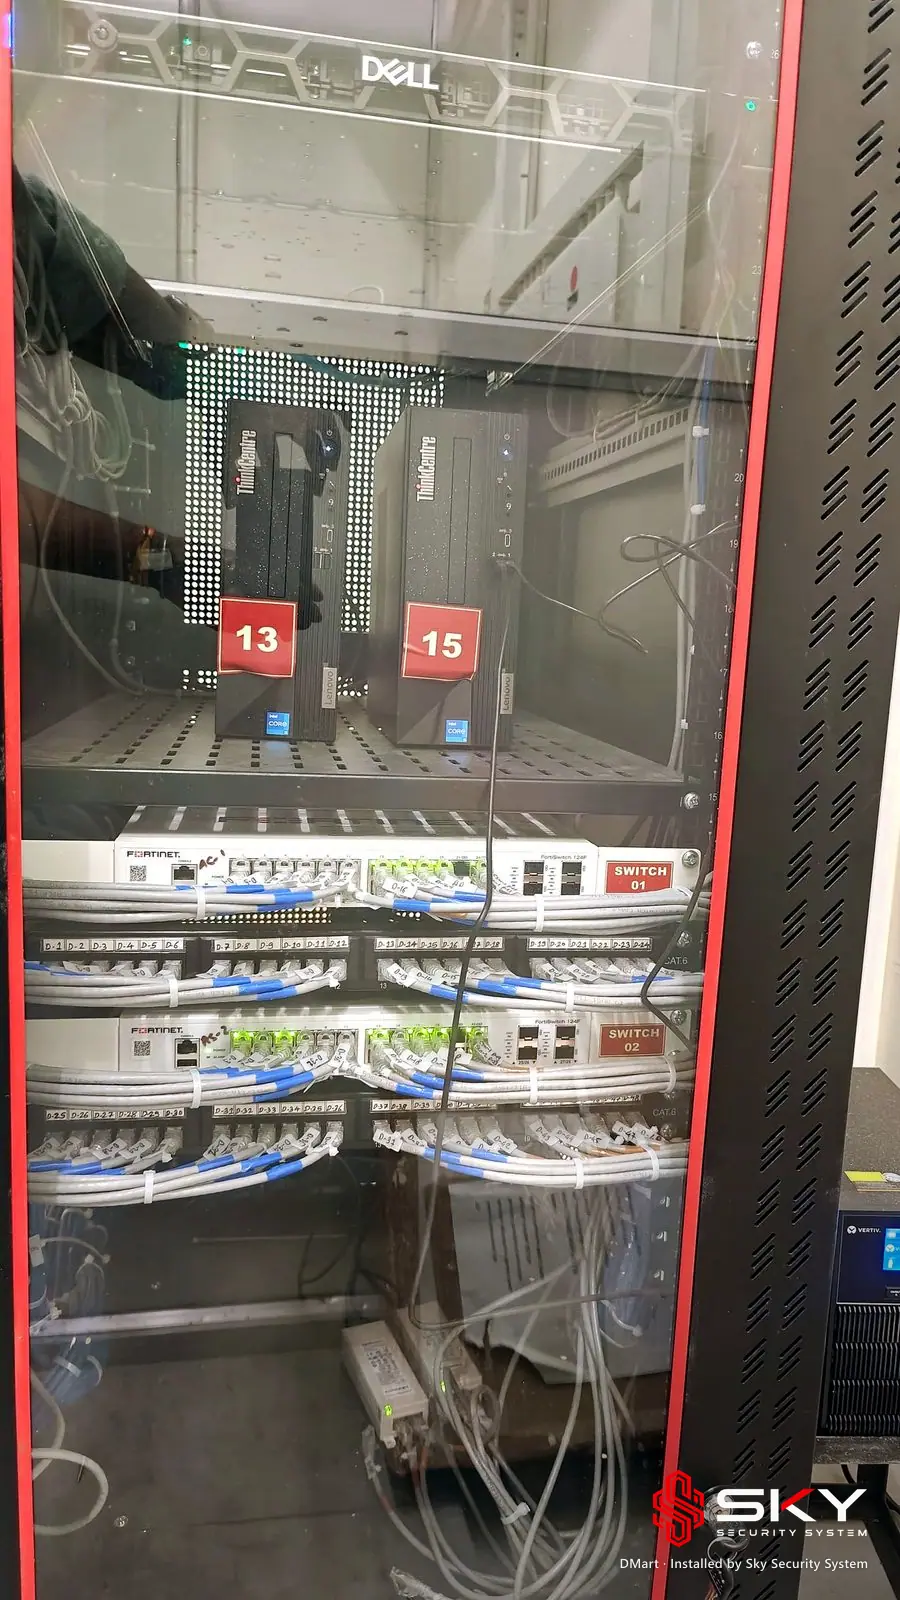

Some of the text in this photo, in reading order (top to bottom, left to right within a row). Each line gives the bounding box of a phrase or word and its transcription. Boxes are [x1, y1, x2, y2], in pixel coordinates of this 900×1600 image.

[361, 55, 439, 91] DELL
[233, 430, 257, 495] ThinkCentre
[415, 436, 437, 502] ThinkCentre
[734, 473, 744, 482] 20
[729, 539, 738, 549] 19
[236, 625, 278, 652] 13
[422, 630, 462, 658] 15
[324, 670, 334, 705] Lenovo
[503, 676, 512, 711] Lenovo
[713, 731, 723, 740] 16
[708, 793, 718, 802] 15
[615, 866, 667, 876] SWITCH
[631, 880, 646, 890] 01
[45, 942, 61, 950] D-1
[68, 942, 84, 951] D-2
[93, 942, 107, 950] D-3
[117, 942, 135, 950] D-4
[141, 941, 157, 949] D-5
[216, 943, 230, 951] D-7
[260, 941, 274, 949] D-9
[378, 938, 394, 947] D-13
[398, 939, 417, 947] D-14
[421, 940, 438, 948] D-15
[443, 940, 458, 948] D-16
[393, 968, 408, 981] D-13
[609, 1029, 660, 1039] SWITCH
[624, 1042, 640, 1052] 02
